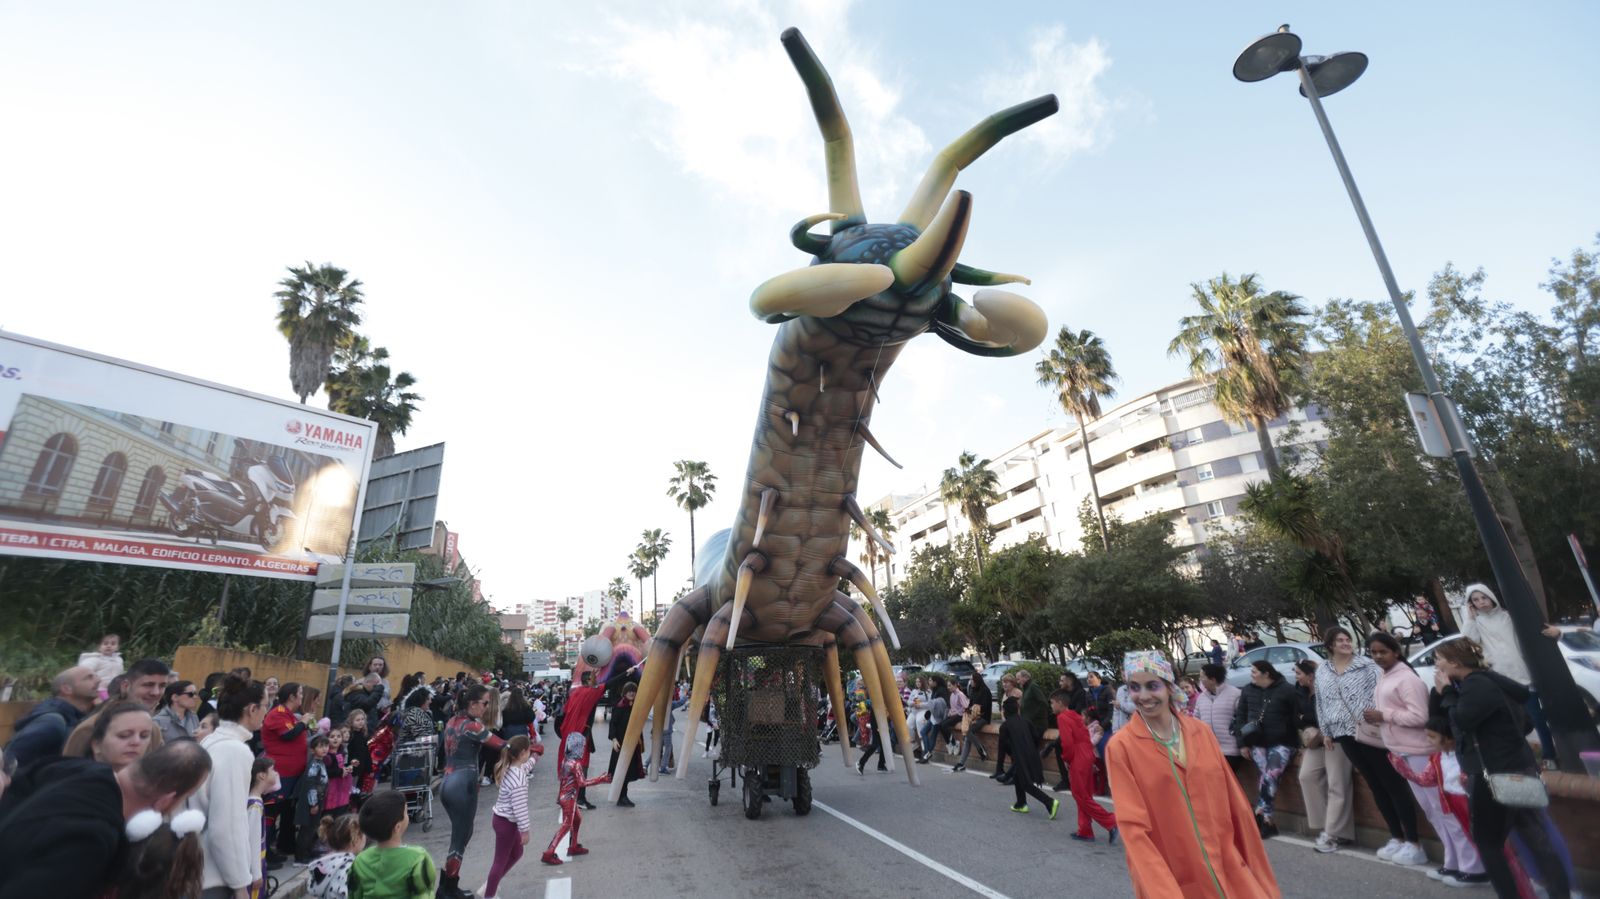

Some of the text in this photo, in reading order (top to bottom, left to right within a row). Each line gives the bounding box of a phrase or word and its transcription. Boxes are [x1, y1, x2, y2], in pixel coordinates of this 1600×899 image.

[305, 423, 362, 449] YAMAHA
[50, 538, 90, 550] CTRA.
[93, 542, 149, 556] MALAGA.
[151, 548, 200, 560] EDIFICIO
[201, 553, 252, 566] LEPANTO.
[253, 559, 310, 573] ALGECIRAS
